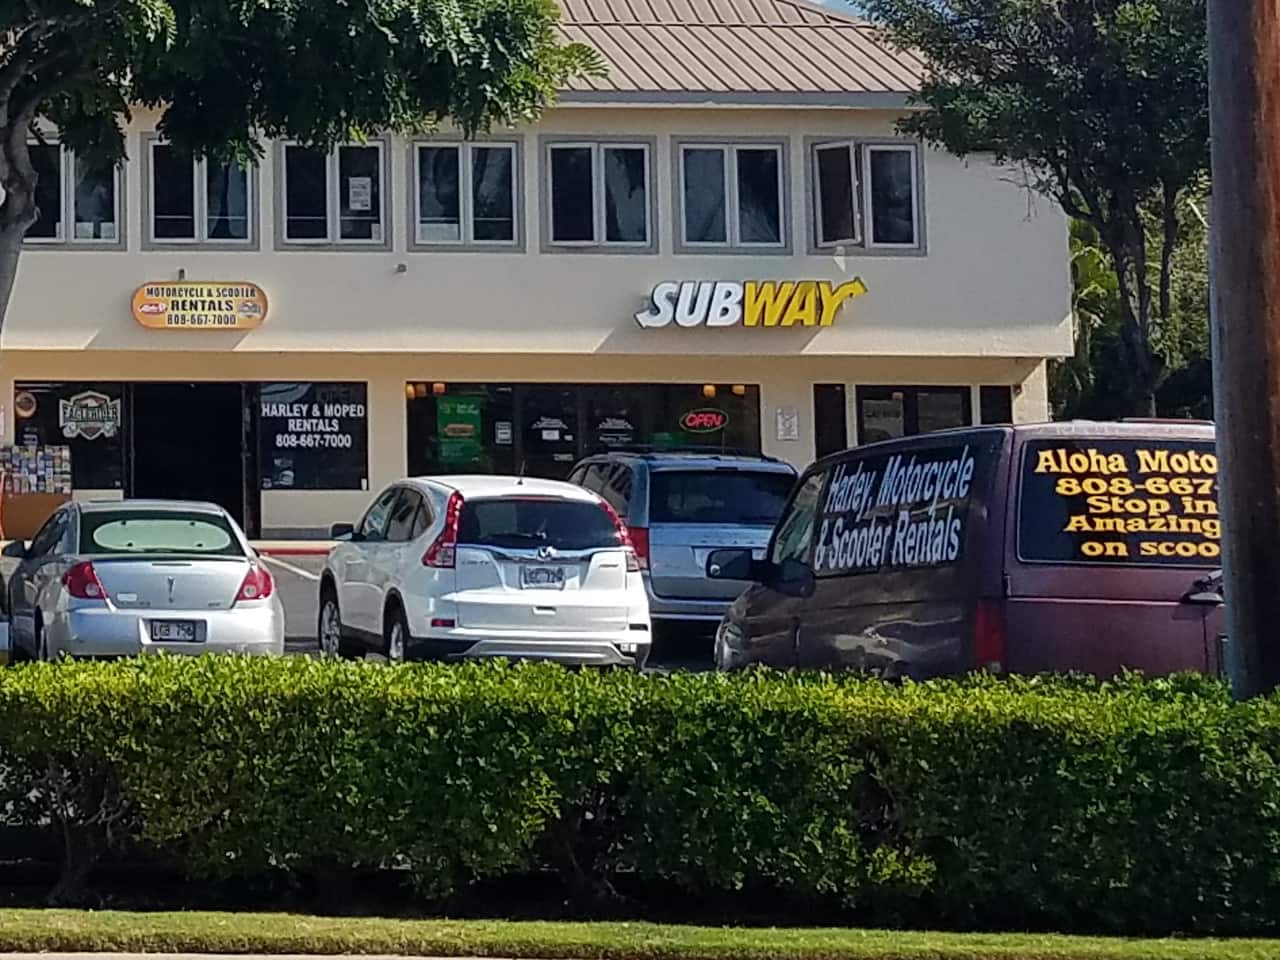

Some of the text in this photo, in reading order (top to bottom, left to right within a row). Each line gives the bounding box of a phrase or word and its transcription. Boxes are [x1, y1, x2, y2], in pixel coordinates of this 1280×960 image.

[146, 287, 203, 297] MOTORCYCLE
[216, 287, 256, 297] SCOOTER
[171, 300, 233, 311] RENTALS
[634, 276, 867, 328] SUBWAY
[167, 314, 236, 325] 808-667-7000
[261, 403, 365, 417] HARLEY & MOPED
[288, 419, 339, 432] RENTALS
[684, 412, 723, 428] OPEN
[275, 434, 352, 448] 808-667-7000
[1034, 448, 1128, 474] Aloha
[824, 445, 974, 522] Harley, Motorcycle
[1087, 496, 1220, 516] Stop in
[1063, 514, 1221, 539] Amazing
[814, 505, 961, 570] & Scooter Rentals
[1081, 541, 1220, 556] on scoo
